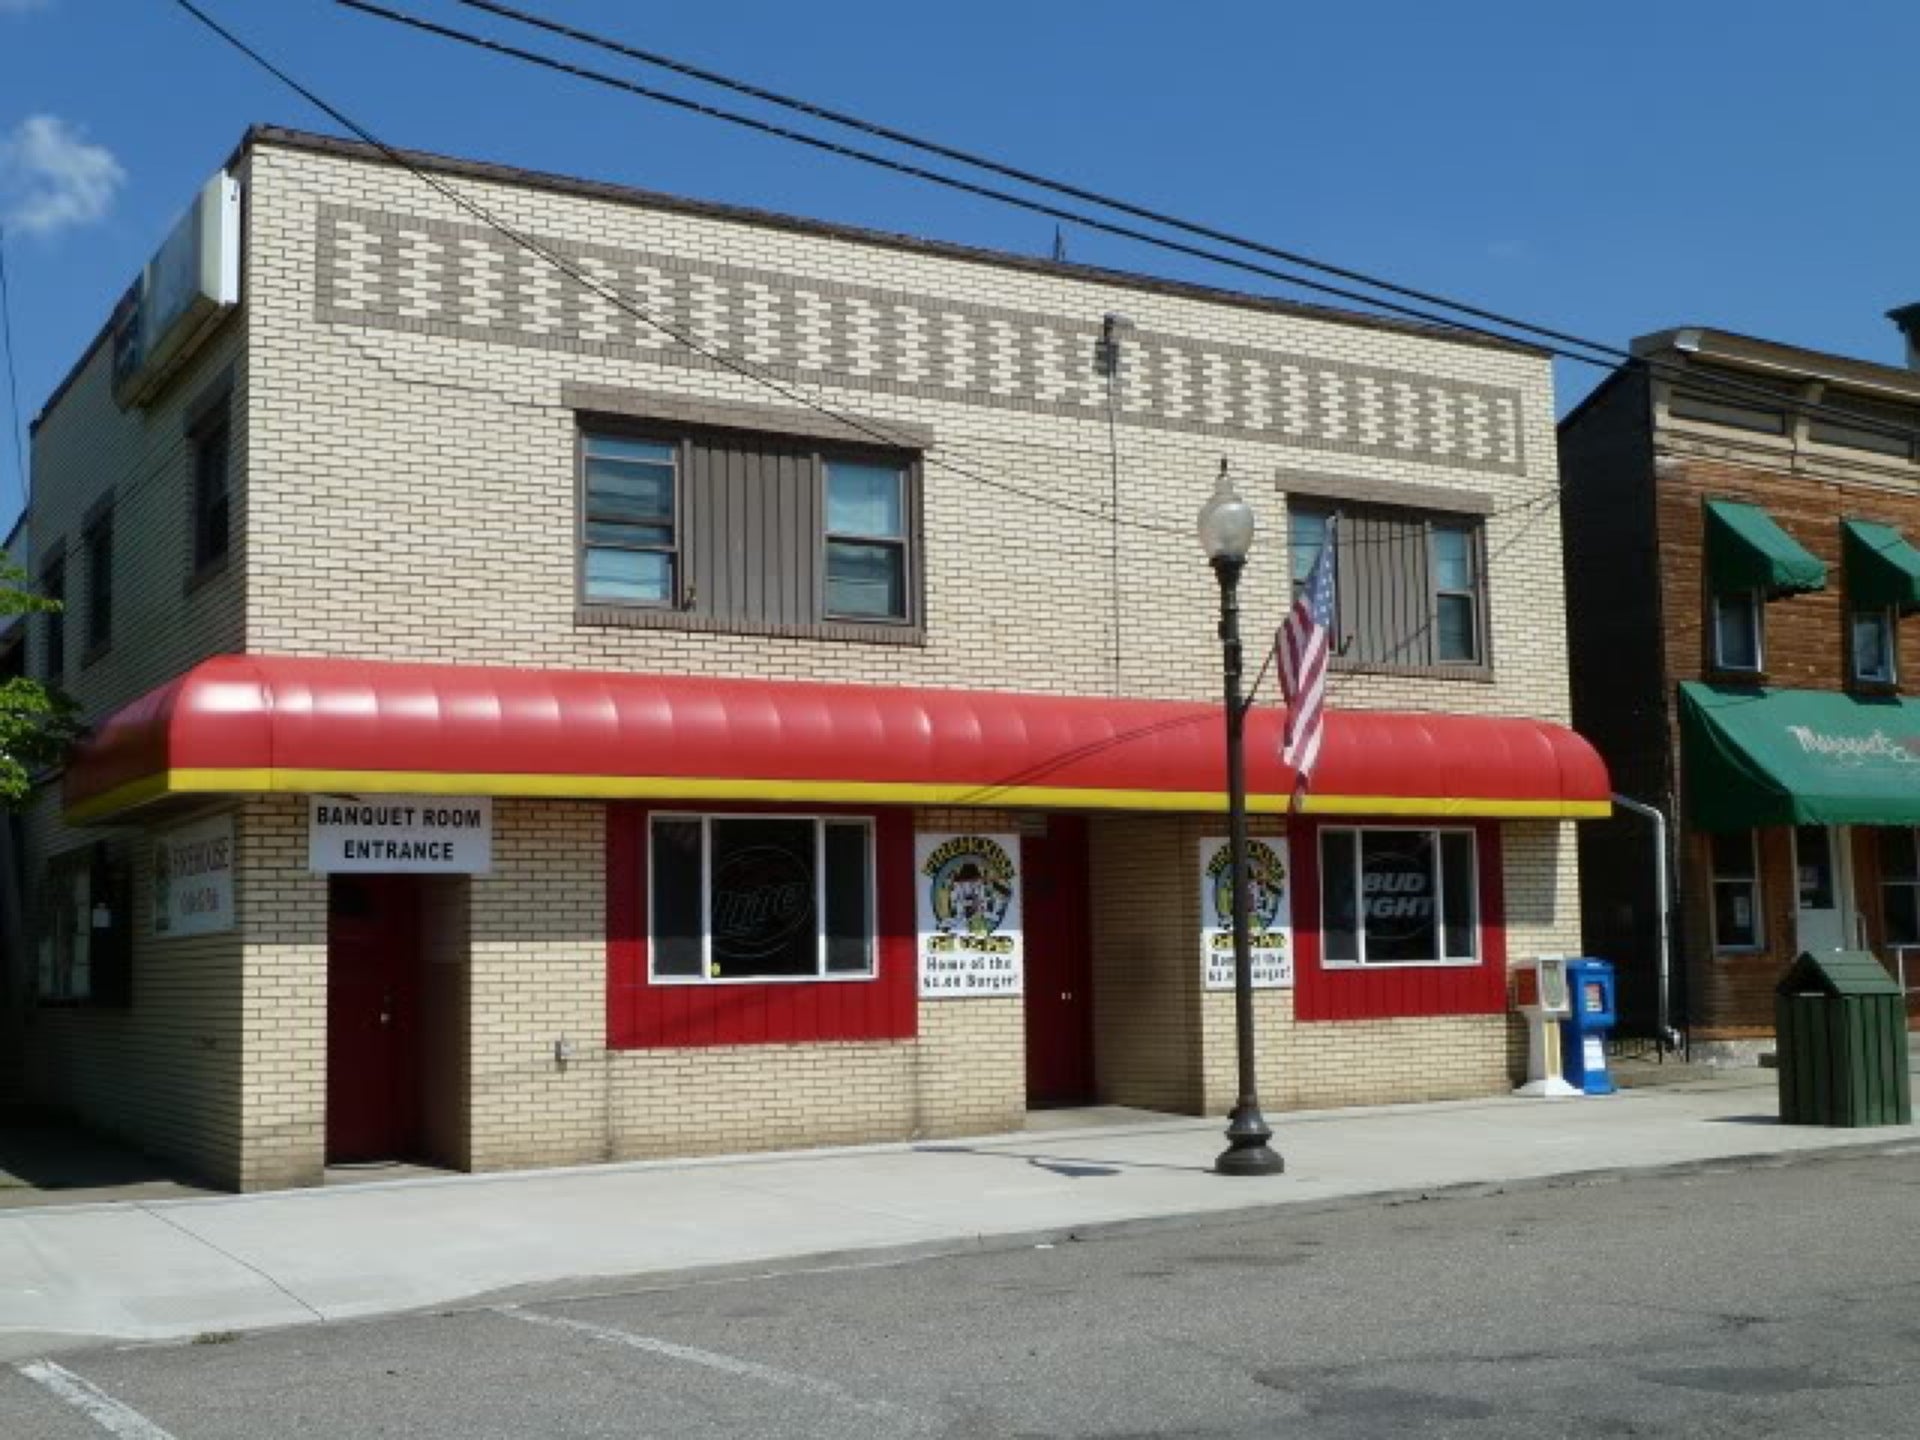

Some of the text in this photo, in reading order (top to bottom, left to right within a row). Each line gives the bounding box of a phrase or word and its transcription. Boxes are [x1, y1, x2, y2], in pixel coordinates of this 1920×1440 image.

[316, 806, 482, 829] BANQUET ROOM
[344, 840, 454, 862] ENTRANCE
[1362, 871, 1427, 893] BUD
[1352, 896, 1435, 919] IGHT
[926, 956, 1013, 971] Home of the
[1252, 965, 1291, 983] urger!
